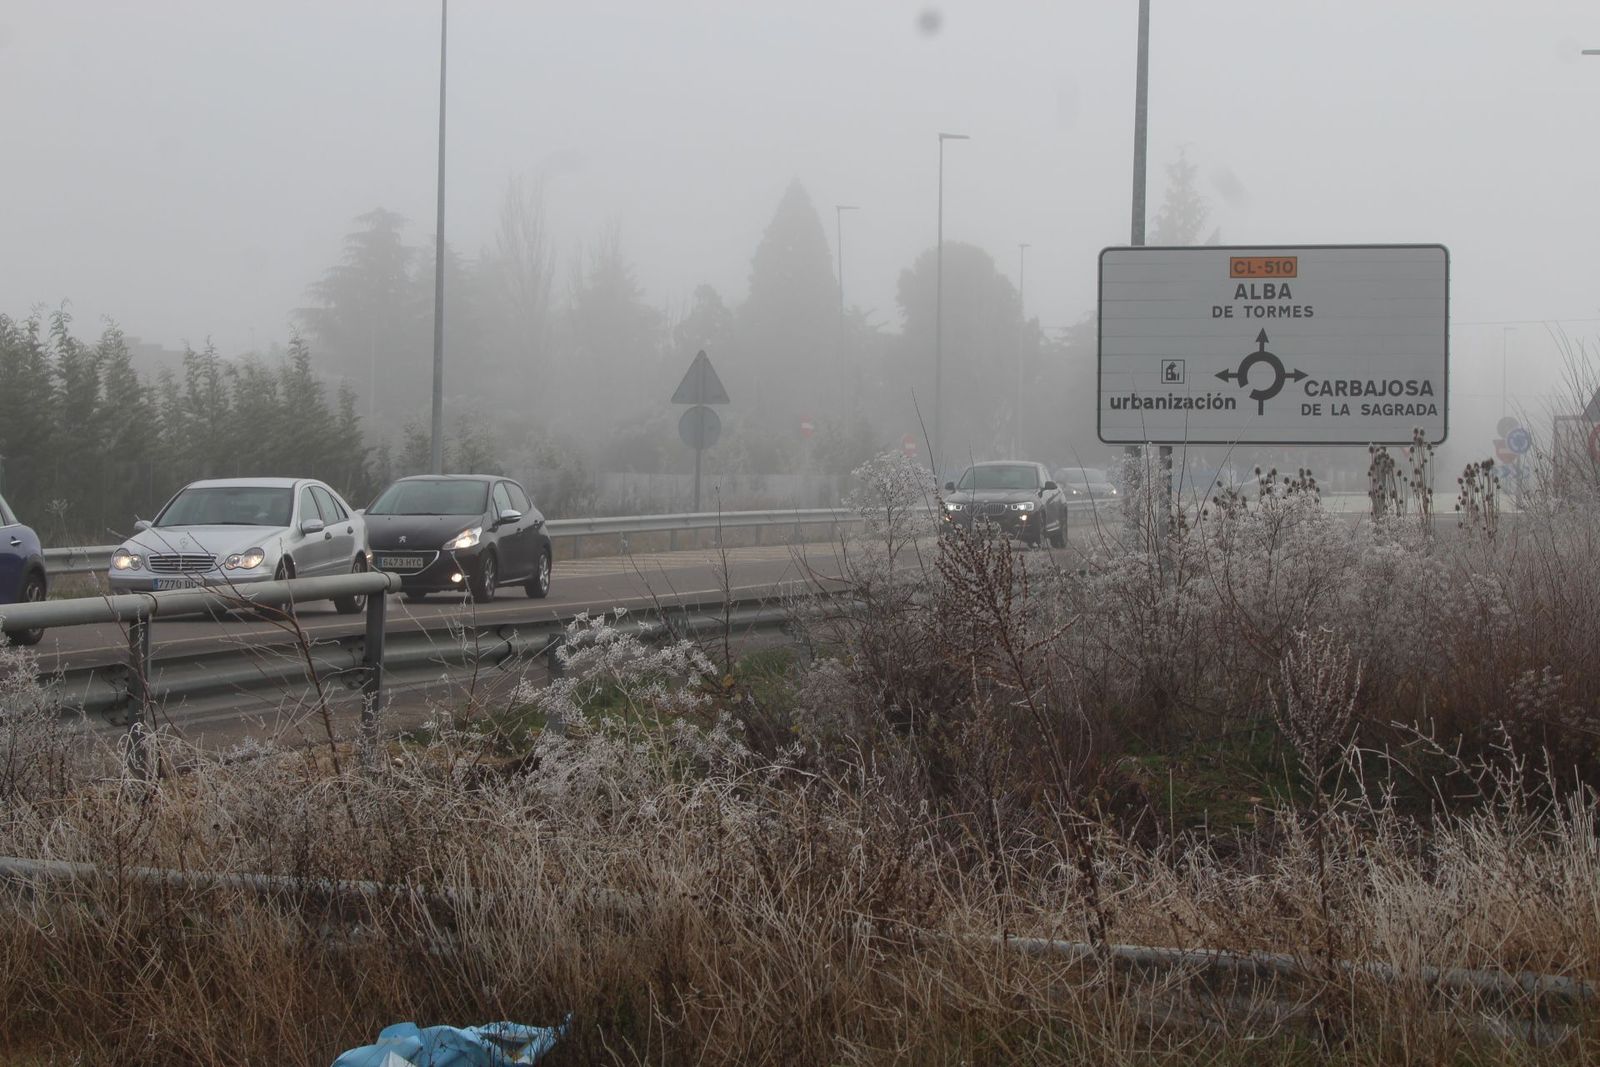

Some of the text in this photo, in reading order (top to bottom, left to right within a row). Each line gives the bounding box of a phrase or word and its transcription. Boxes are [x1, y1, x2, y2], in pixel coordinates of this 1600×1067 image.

[1233, 261, 1294, 274] CL-510
[1234, 283, 1292, 300] ALBA
[1212, 305, 1315, 318] DE TORMES
[1304, 380, 1434, 397] CARBAJOSA
[1110, 392, 1237, 410] urbanización
[1301, 403, 1438, 416] DE LA SAGRADA
